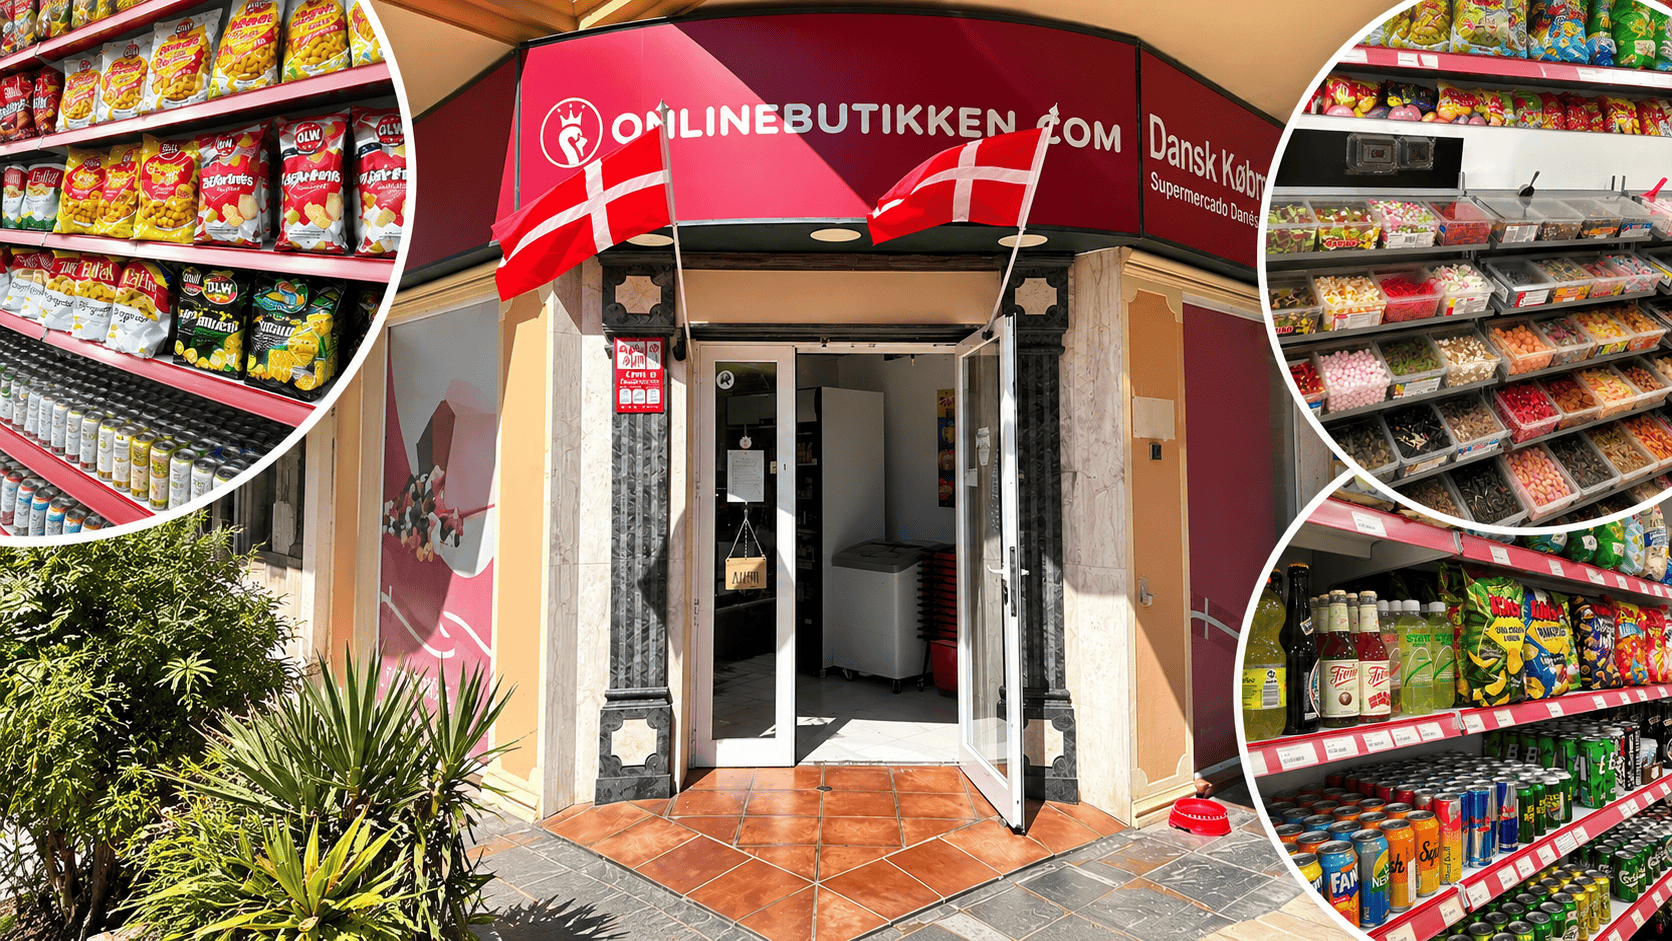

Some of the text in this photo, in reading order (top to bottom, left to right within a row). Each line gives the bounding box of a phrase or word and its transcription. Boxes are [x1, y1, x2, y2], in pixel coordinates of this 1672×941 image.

[297, 128, 321, 144] OLW
[1149, 113, 1218, 183] Dansk
[1150, 171, 1259, 229] Supermercado Danés
